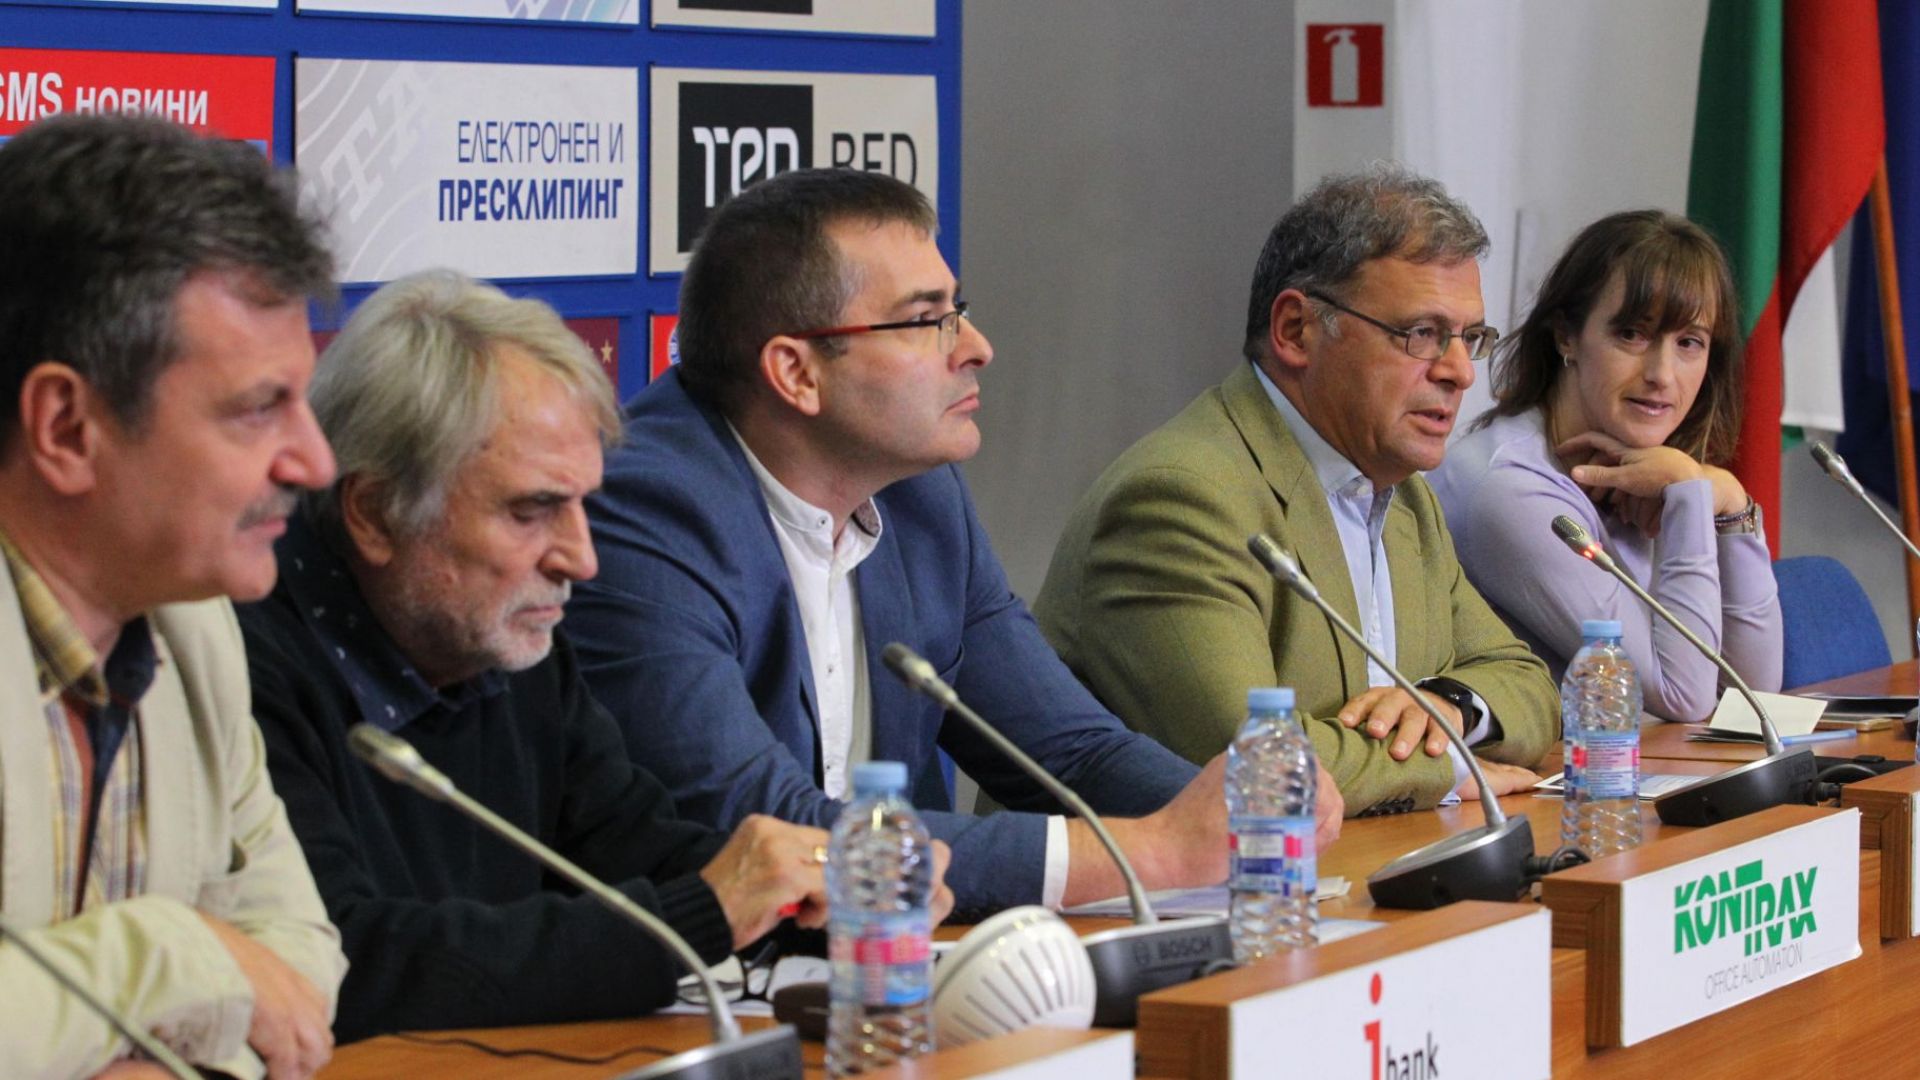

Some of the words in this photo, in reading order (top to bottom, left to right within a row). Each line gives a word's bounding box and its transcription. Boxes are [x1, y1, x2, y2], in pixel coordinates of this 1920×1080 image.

[0, 71, 62, 121] MS
[458, 121, 600, 163] ЕЛЕКТРОНЕН
[609, 122, 624, 163] И
[438, 178, 624, 222] ПРЕСКЛИПИНГ
[1674, 859, 1818, 957] KONTRAX
[1157, 936, 1212, 960] BOSCH
[1704, 964, 1739, 999] OFFICE
[1741, 942, 1803, 984] AUTOMATION
